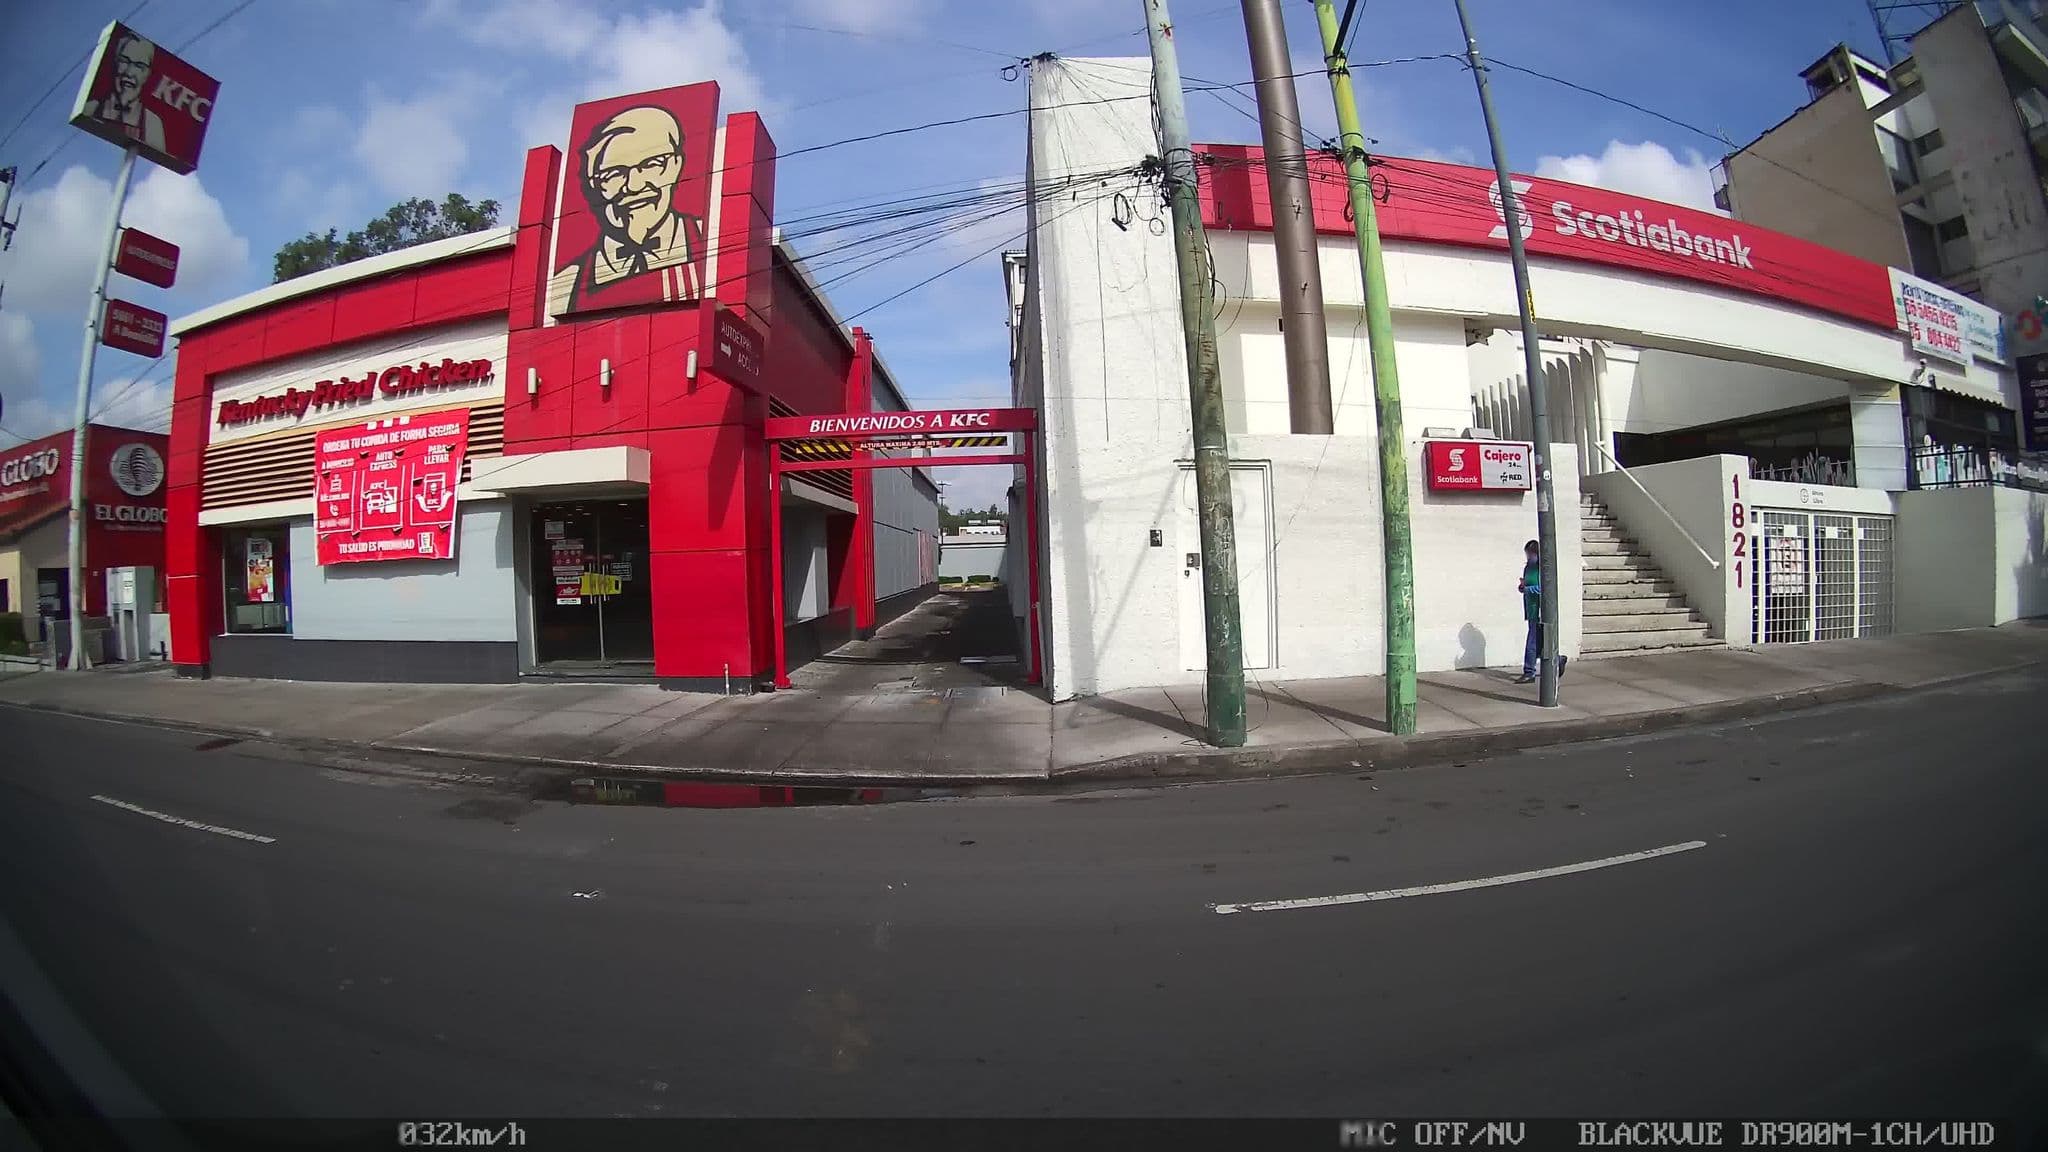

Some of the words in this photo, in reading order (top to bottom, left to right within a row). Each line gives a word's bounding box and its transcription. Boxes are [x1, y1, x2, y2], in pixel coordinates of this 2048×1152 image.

[152, 75, 212, 122] KFC
[1551, 200, 1753, 269] Scotiabank
[217, 386, 314, 424] Kentucky
[312, 371, 378, 407] Fried
[378, 358, 491, 395] Chicken
[389, 431, 400, 443] DE
[400, 427, 428, 442] FORMA
[427, 423, 460, 439] SEGURA
[809, 415, 926, 433] BIENVENIDOS
[930, 414, 943, 428] A
[949, 413, 990, 427] KFC
[1484, 449, 1522, 464] Cajero
[1, 448, 59, 487] GLOBO
[1437, 475, 1478, 484] Scotiabank
[95, 503, 115, 521] EL
